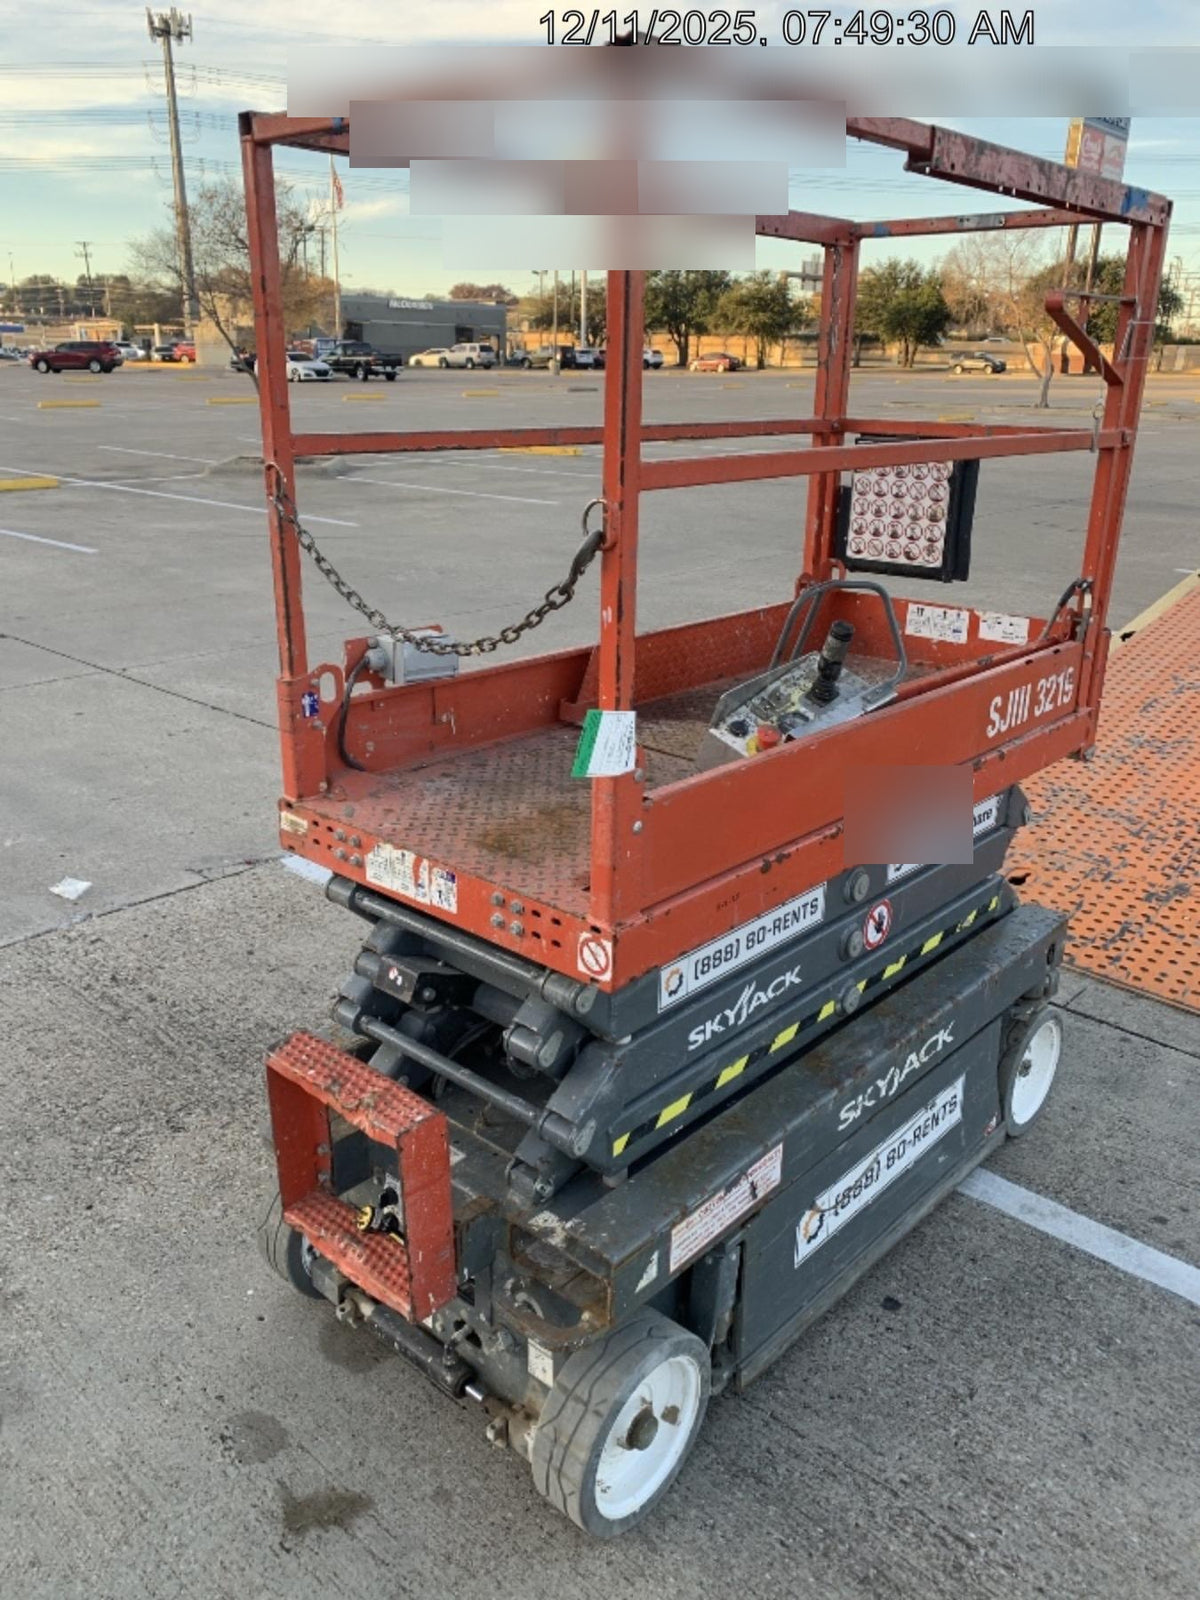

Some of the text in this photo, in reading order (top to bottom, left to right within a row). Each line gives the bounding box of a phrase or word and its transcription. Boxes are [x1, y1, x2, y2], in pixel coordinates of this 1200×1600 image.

[1034, 666, 1075, 718] 3215
[694, 938, 741, 981] (888)
[687, 964, 803, 1052] SKYJACK
[837, 1020, 956, 1132] SKYJACK
